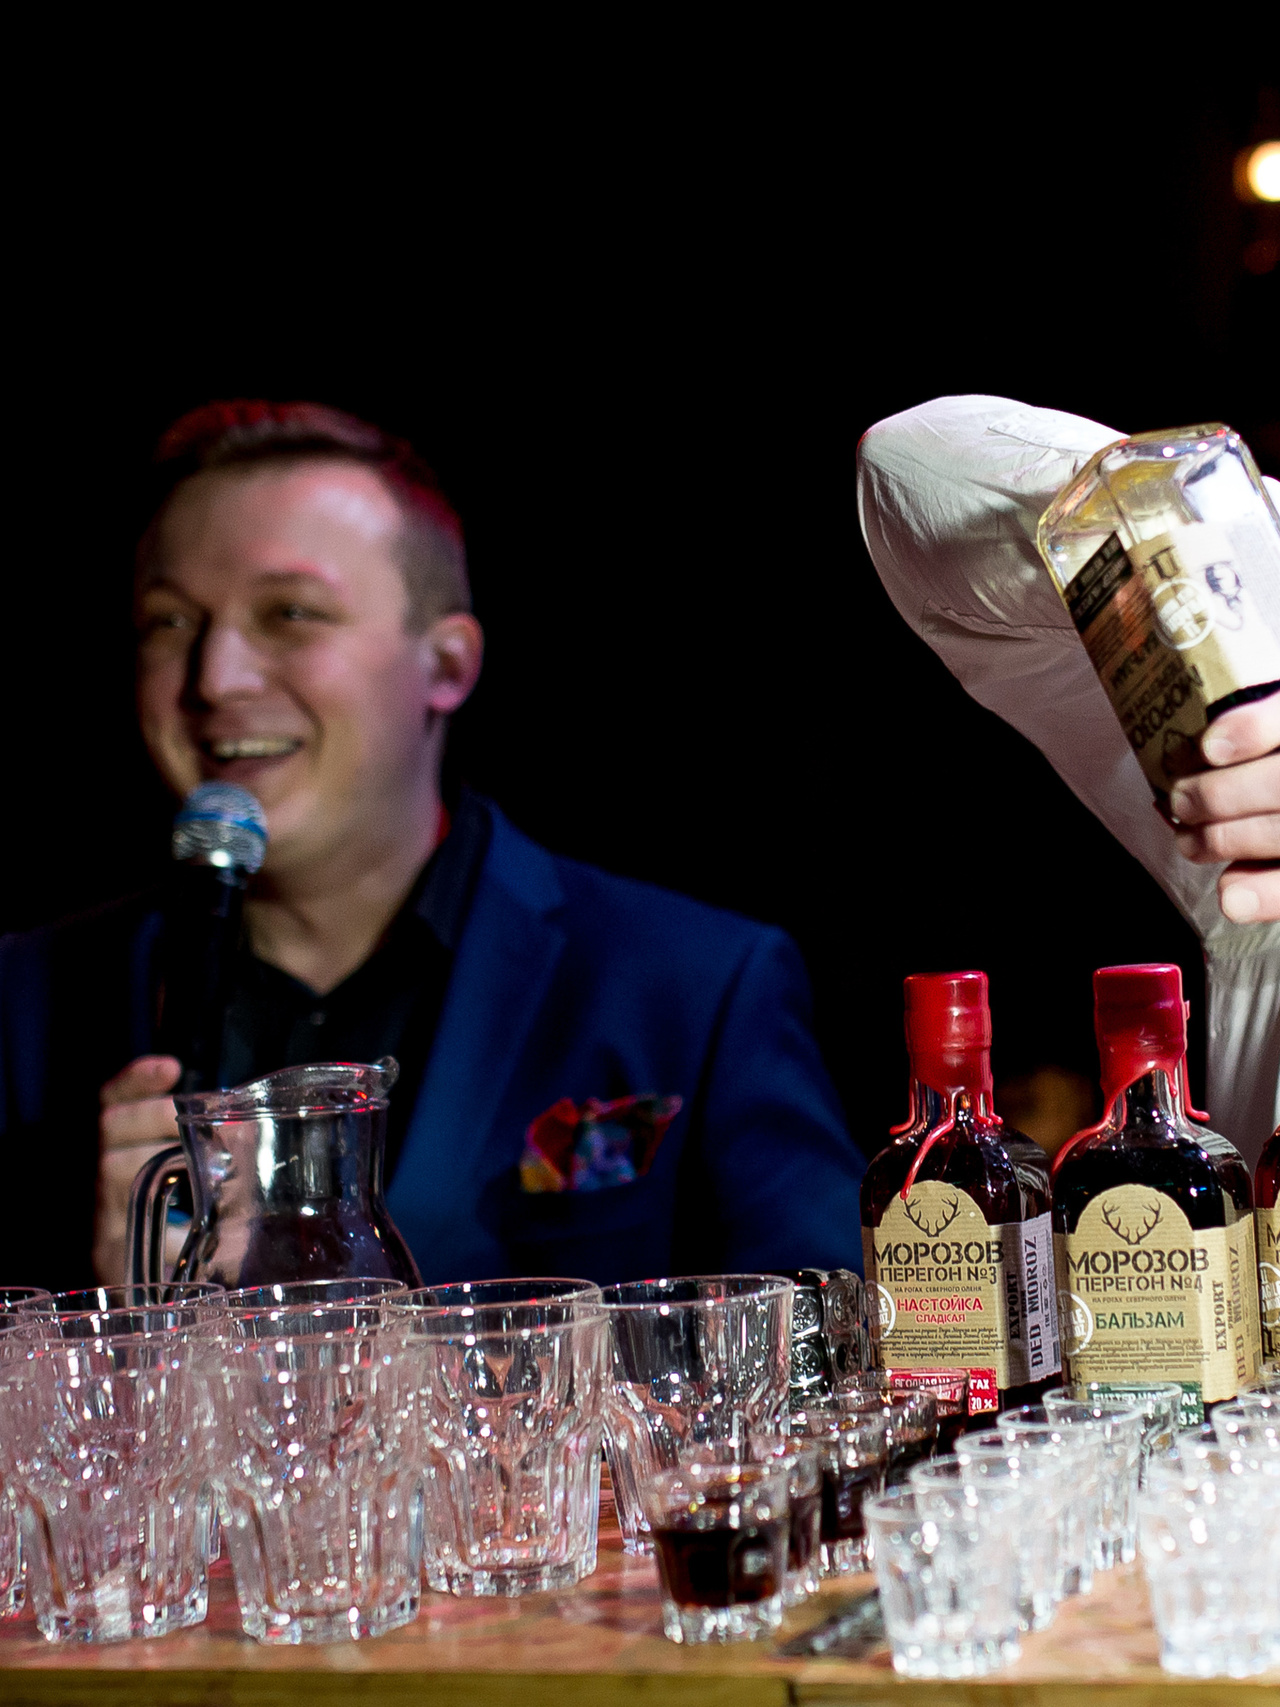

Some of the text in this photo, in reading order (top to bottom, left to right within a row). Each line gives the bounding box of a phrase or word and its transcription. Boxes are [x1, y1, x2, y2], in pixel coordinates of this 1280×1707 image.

[873, 1241, 1005, 1267] МОРОЗОВ
[1066, 1248, 1210, 1276] МОРОЗОВ
[880, 1266, 962, 1283] ПЕРЕГОН
[1076, 1275, 1165, 1292] ПЕРЕГОН
[896, 1294, 984, 1312] НАСТОЙКА
[1005, 1271, 1021, 1340] EXPORT
[1024, 1236, 1043, 1368] DED MOROZ
[915, 1313, 966, 1325] СЛАДКАЯ
[1095, 1311, 1184, 1329] БАЛЬЗАМ
[1212, 1280, 1227, 1352] EXPORT
[971, 1397, 982, 1410] 20
